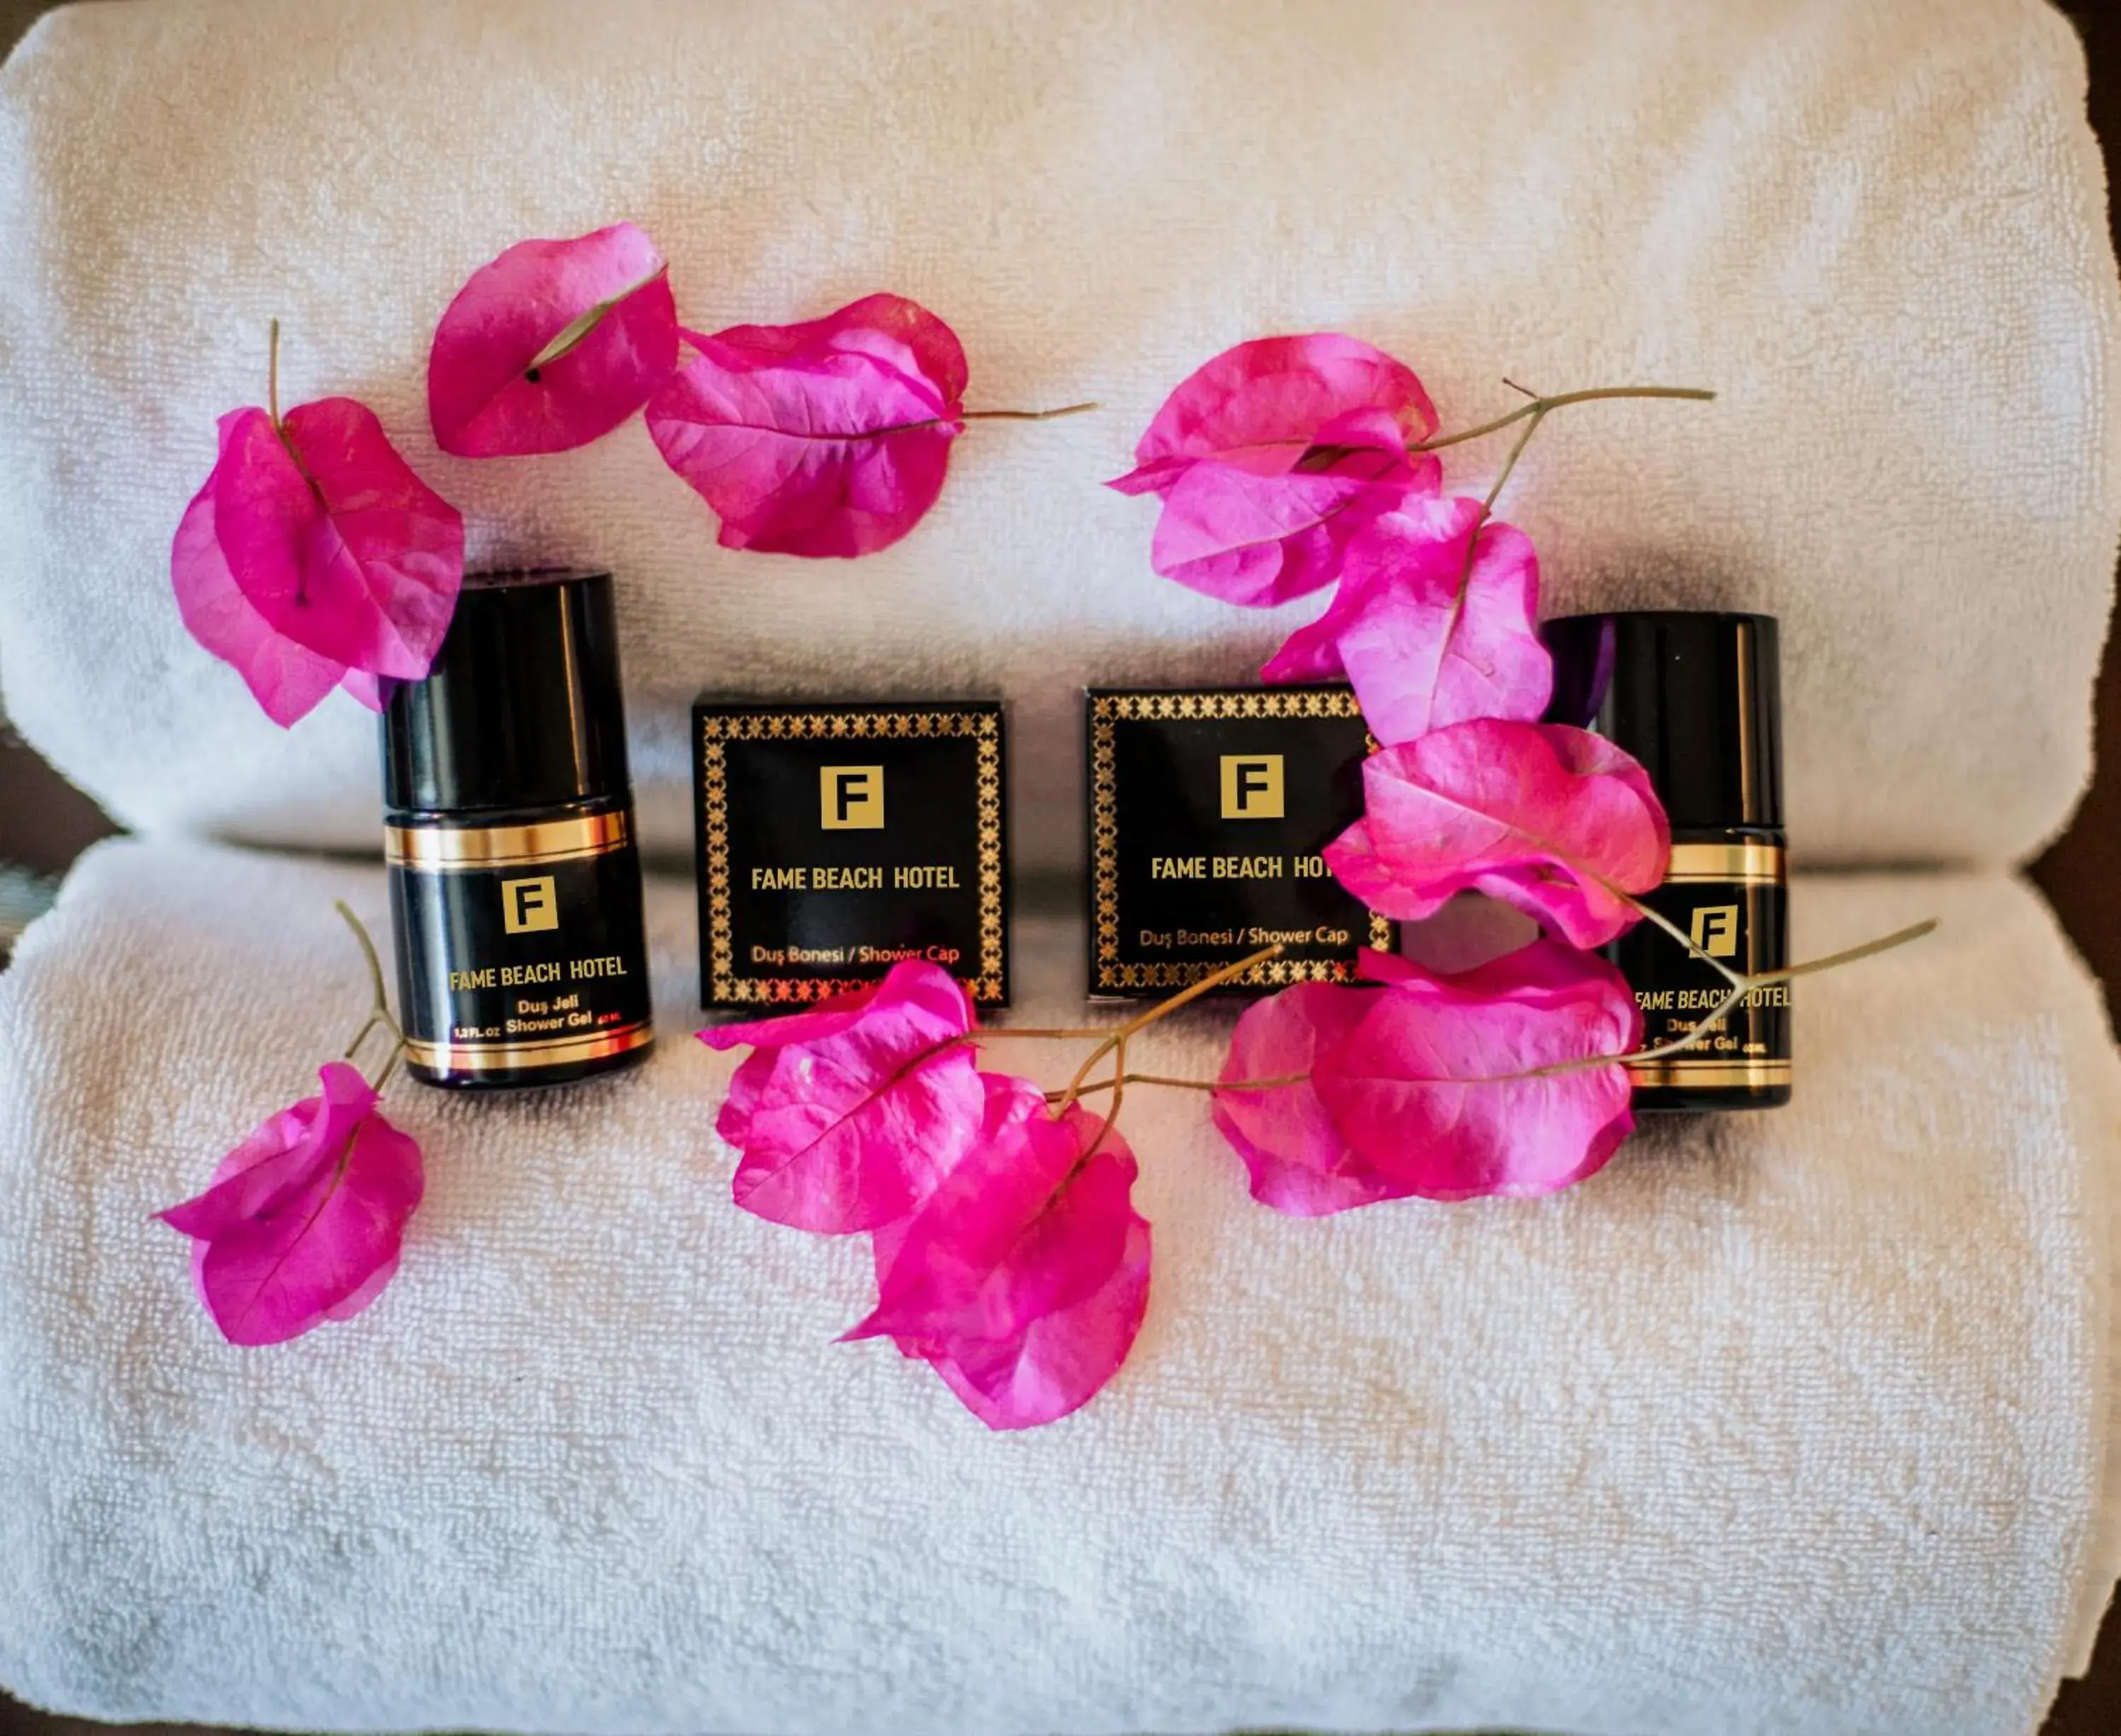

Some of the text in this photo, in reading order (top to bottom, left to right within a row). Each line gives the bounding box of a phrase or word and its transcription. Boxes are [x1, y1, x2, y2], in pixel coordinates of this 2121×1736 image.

[752, 867, 960, 890] FAME BEACH HOTEL
[1152, 857, 1206, 879] FAME
[1212, 857, 1282, 878] BEACH
[1140, 929, 1171, 949] Duş
[1177, 928, 1232, 945] Bonesi
[1249, 927, 1311, 944] Shower
[1315, 926, 1348, 946] Cap
[752, 946, 784, 966] Duş
[788, 946, 843, 963] Bonesi
[859, 946, 922, 962] Shower
[927, 945, 960, 964] Cap
[450, 956, 627, 991] FAME BEACH HOTEL
[553, 995, 579, 1010] Jeli
[1635, 991, 1674, 1010] FAME
[506, 1017, 565, 1033] Shower
[568, 1011, 592, 1026] Gel
[1714, 1036, 1738, 1050] Gel
